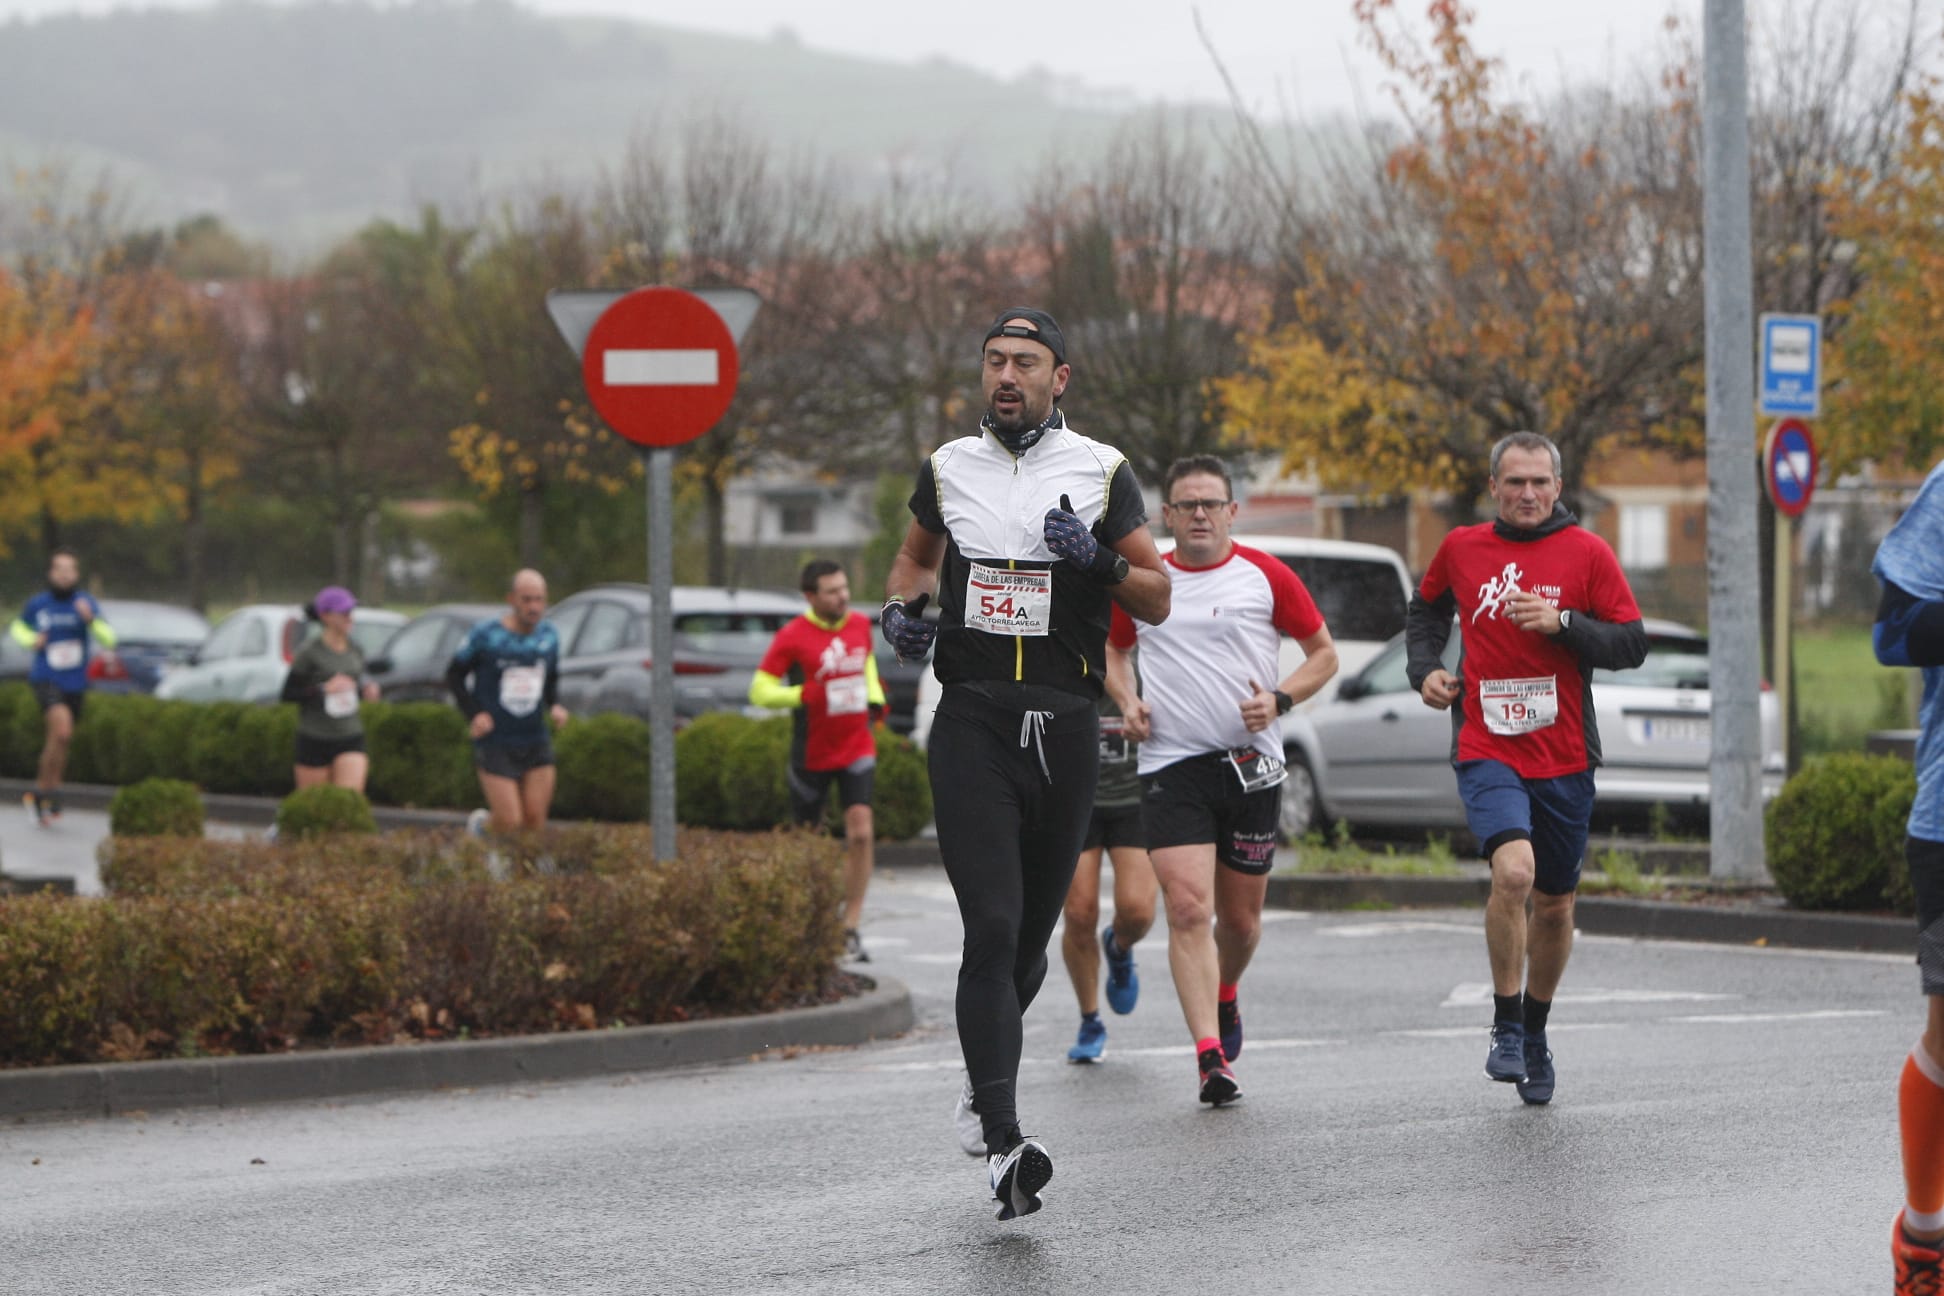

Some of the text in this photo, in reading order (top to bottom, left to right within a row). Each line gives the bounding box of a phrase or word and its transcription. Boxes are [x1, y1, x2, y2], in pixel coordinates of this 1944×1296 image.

[991, 575, 999, 583] DE
[1001, 576, 1012, 584] LAS
[988, 618, 1041, 626] TORRELAVEGA
